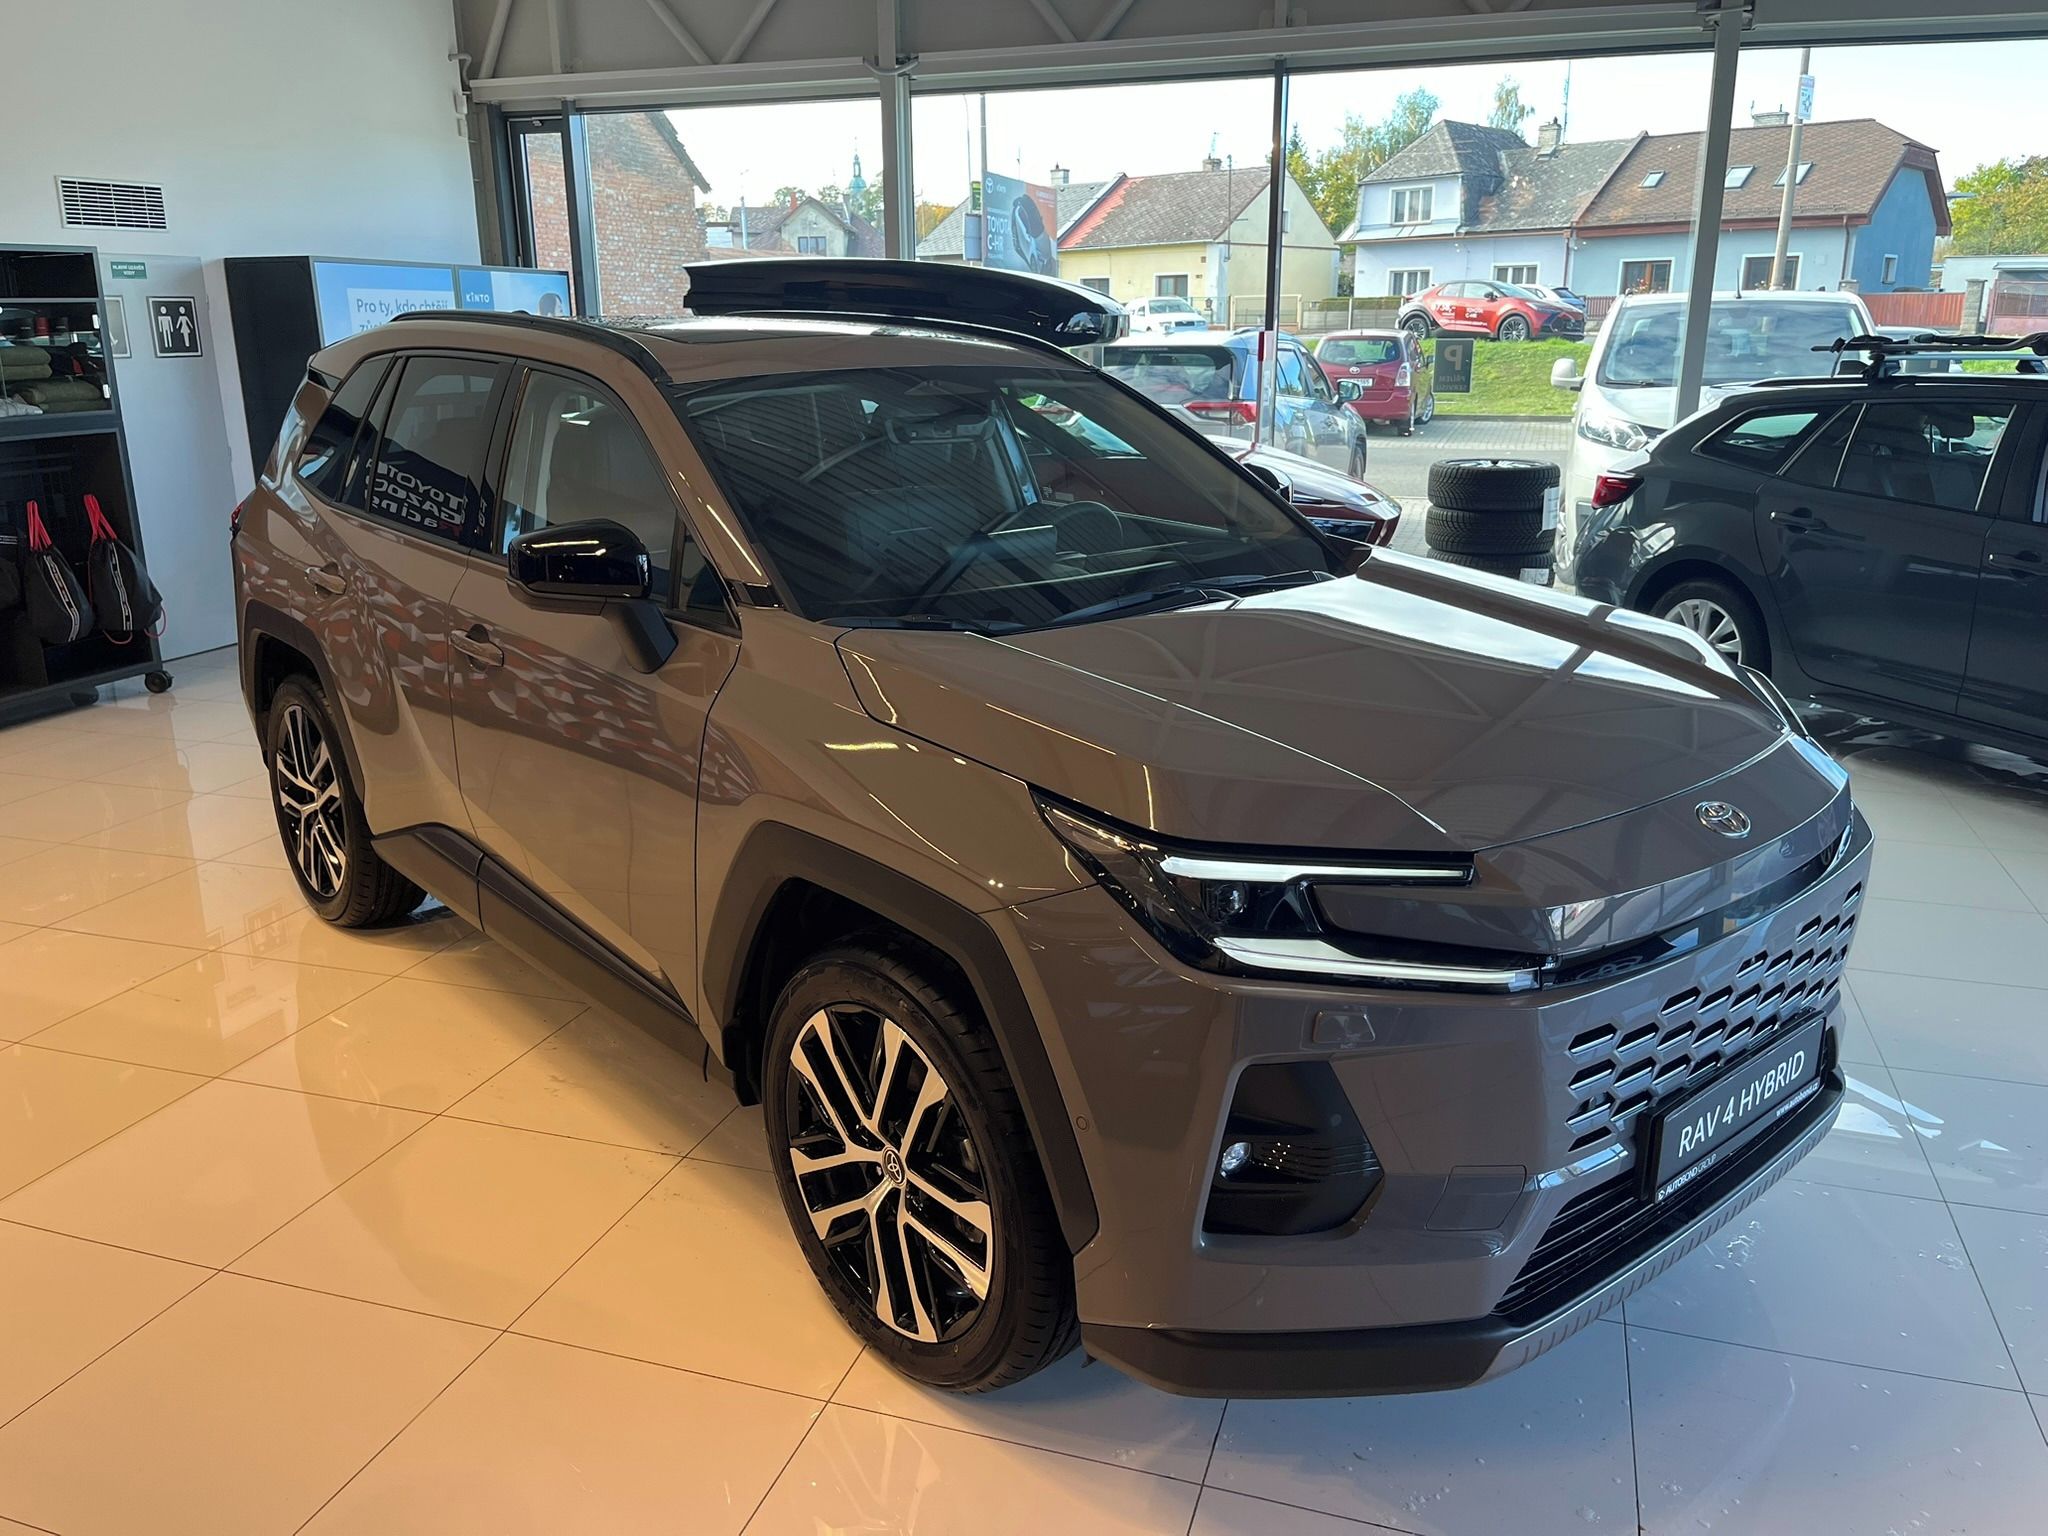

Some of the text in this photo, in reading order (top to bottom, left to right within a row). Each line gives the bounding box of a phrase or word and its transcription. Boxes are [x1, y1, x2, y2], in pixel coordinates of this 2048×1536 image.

[356, 298, 377, 313] Pro
[379, 300, 394, 317] ty,
[1678, 1051, 1806, 1158] RAV 4 HYBRID
[1665, 1166, 1698, 1196] AUTOBOND
